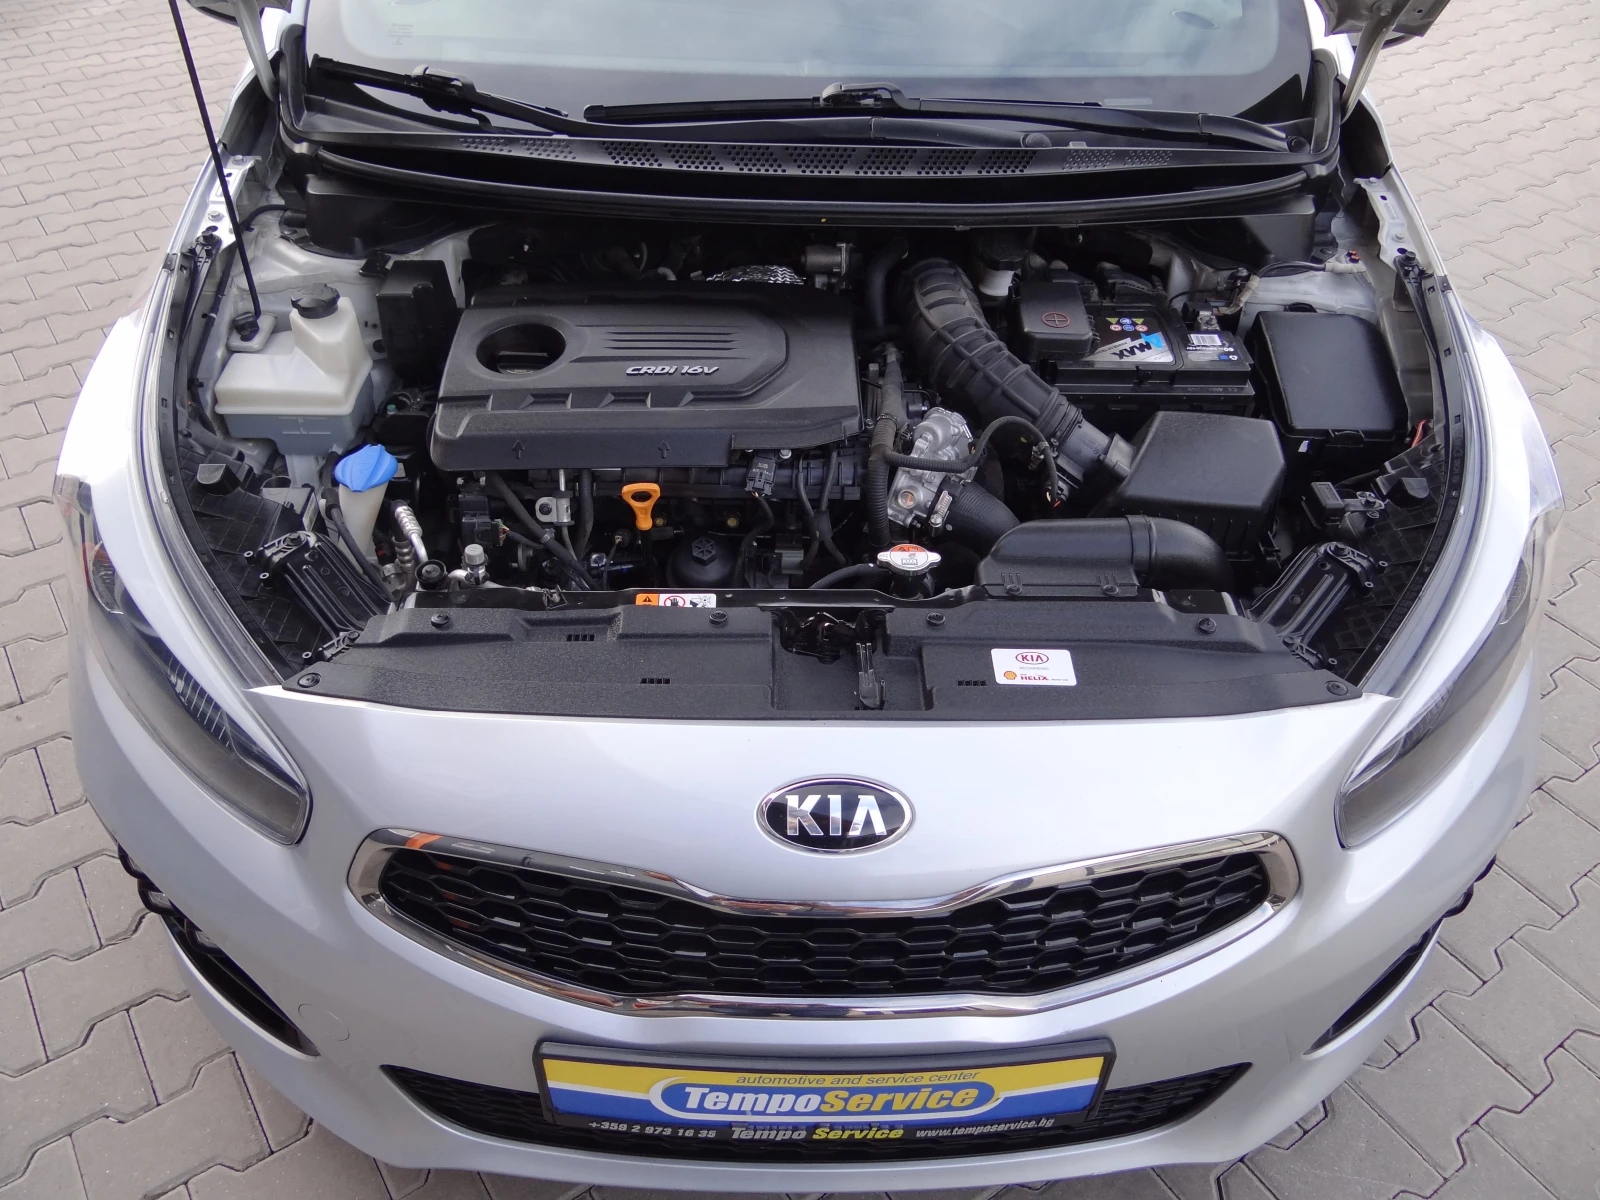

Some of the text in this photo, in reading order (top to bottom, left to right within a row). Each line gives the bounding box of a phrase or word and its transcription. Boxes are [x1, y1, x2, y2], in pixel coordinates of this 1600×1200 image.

[1111, 341, 1152, 360] MAX
[680, 365, 719, 376] 16V
[1020, 654, 1044, 662] KIA
[785, 794, 887, 836] KIA
[736, 1071, 979, 1085] automotive and service center
[588, 1121, 716, 1138] +359 2 973 16 35
[731, 1127, 904, 1141] Tempo Service
[916, 1118, 1054, 1137] www.temposervice.bg
